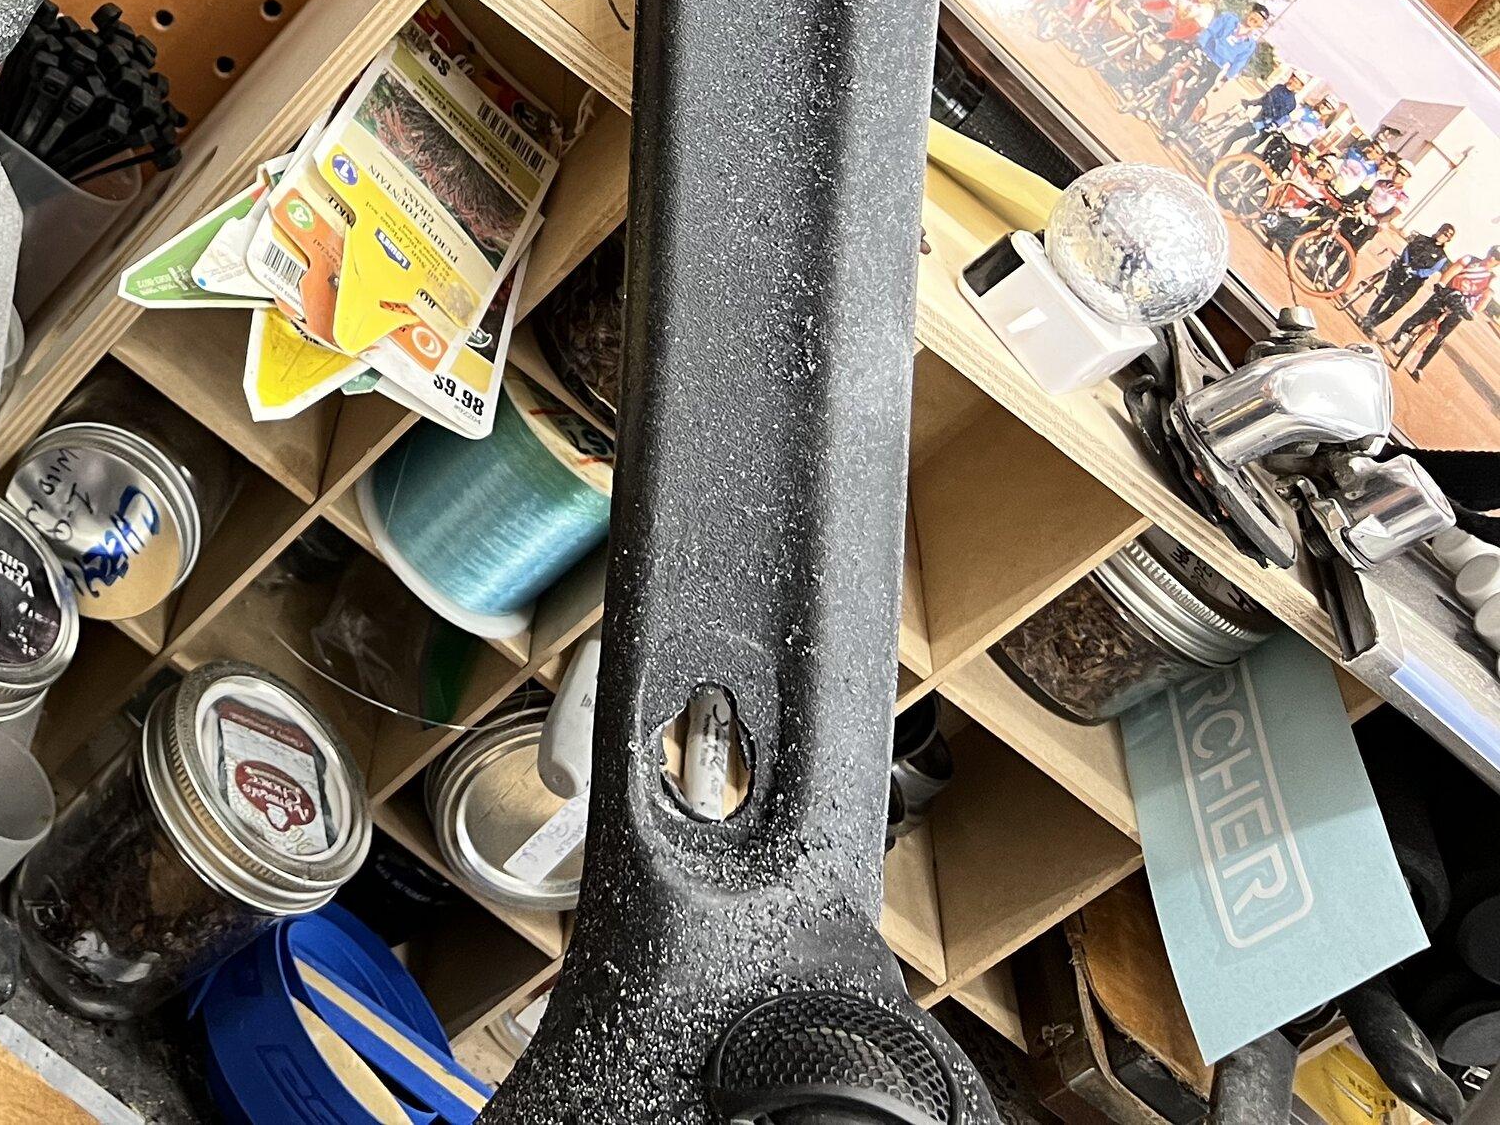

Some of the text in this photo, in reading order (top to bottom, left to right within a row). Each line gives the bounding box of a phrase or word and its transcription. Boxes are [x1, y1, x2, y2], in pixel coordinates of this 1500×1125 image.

[368, 164, 420, 222] FOUNTAIN
[403, 186, 435, 224] GRASS
[420, 217, 459, 264] PURPLE
[433, 374, 485, 416] $9.98
